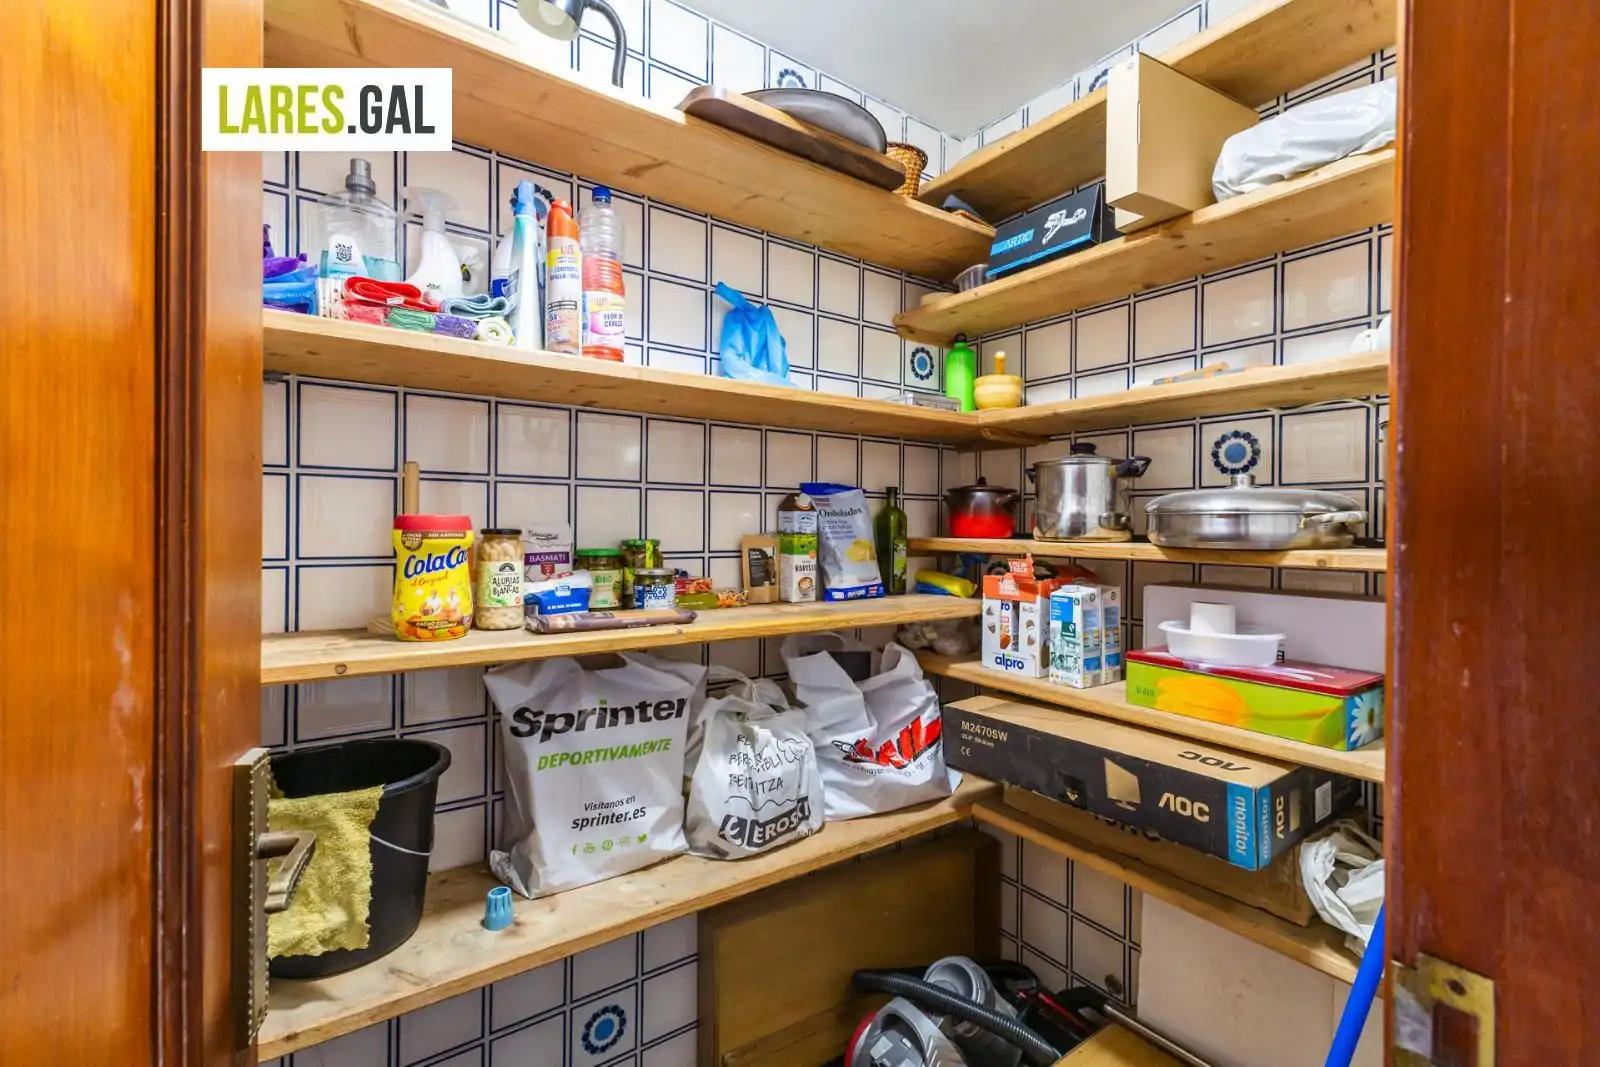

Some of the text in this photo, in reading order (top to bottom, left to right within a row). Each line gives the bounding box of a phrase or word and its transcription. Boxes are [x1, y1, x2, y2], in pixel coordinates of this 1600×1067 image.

[529, 554, 566, 563] BASMATI
[994, 653, 1025, 670] alpro
[510, 698, 688, 743] Sprinter
[961, 720, 1008, 741] M2470SW
[537, 738, 673, 771] DEPORTIVAMENTE
[1177, 750, 1250, 772] AOC
[571, 806, 647, 831] sprinter.es
[752, 801, 809, 844] EROSKI
[1158, 792, 1210, 823] AOC
[1275, 795, 1286, 840] AOC
[1234, 795, 1247, 857] monitor
[1261, 797, 1270, 860] monitor
